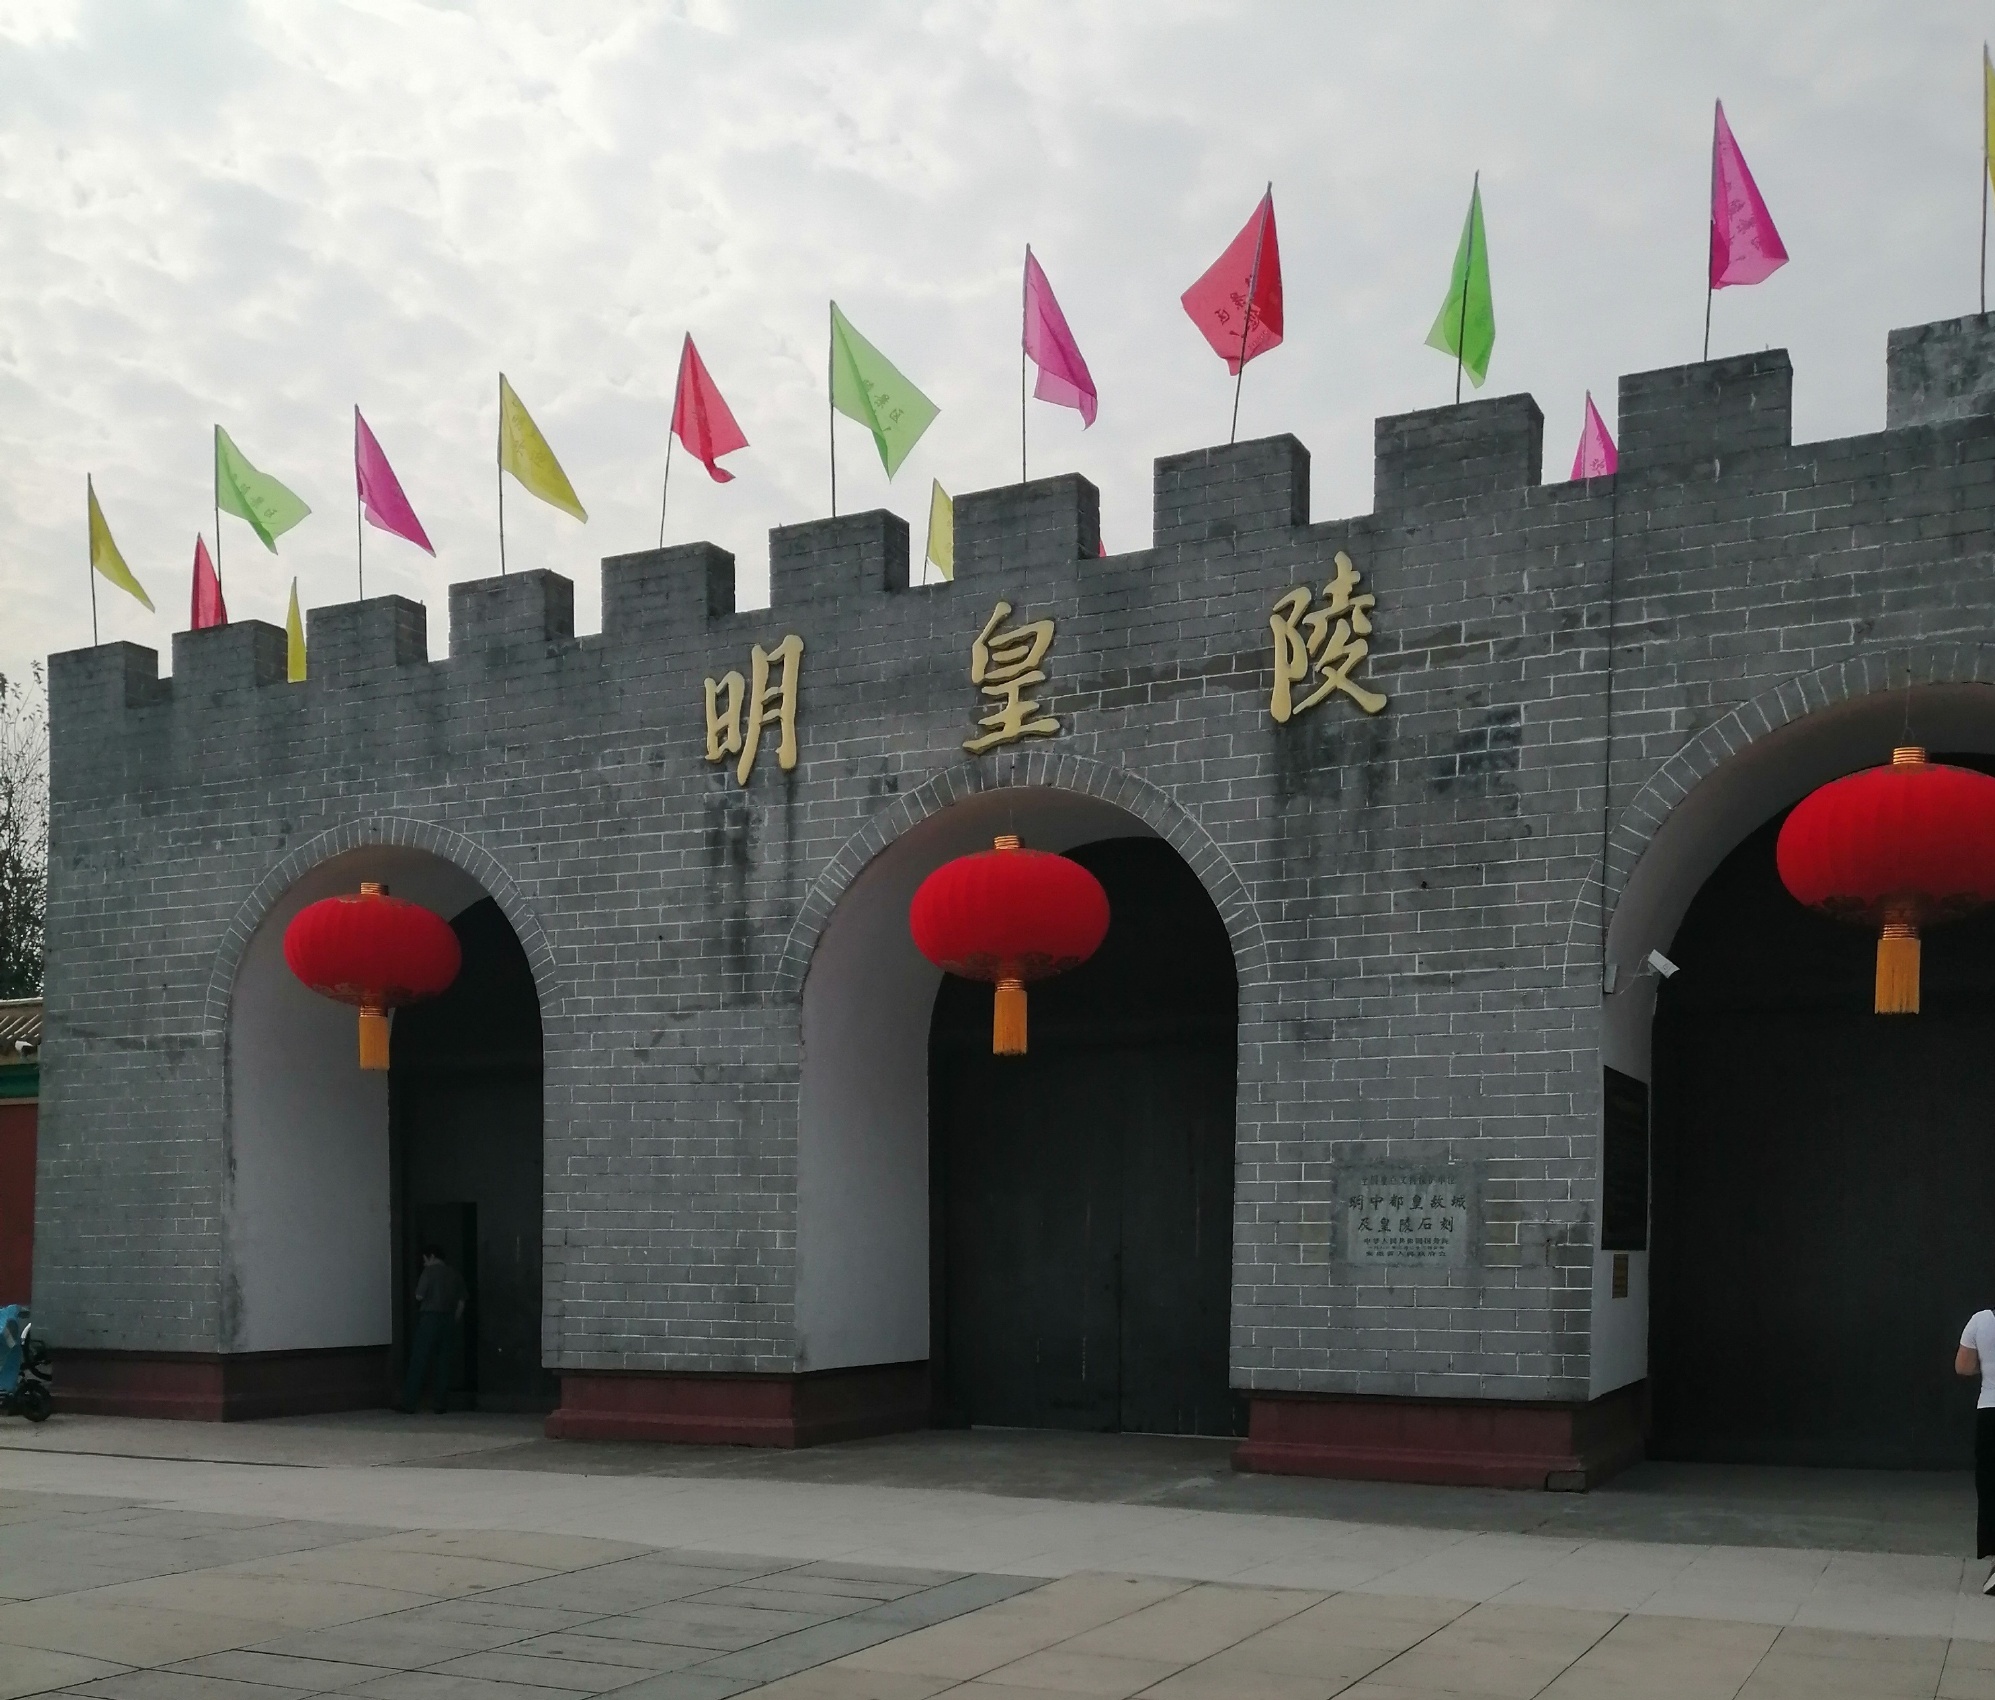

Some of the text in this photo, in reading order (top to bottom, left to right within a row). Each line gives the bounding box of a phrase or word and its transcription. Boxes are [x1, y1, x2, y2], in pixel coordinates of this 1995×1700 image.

[703, 550, 1388, 786] 明皇陵
[1357, 1216, 1454, 1233] 及皇陵石刻
